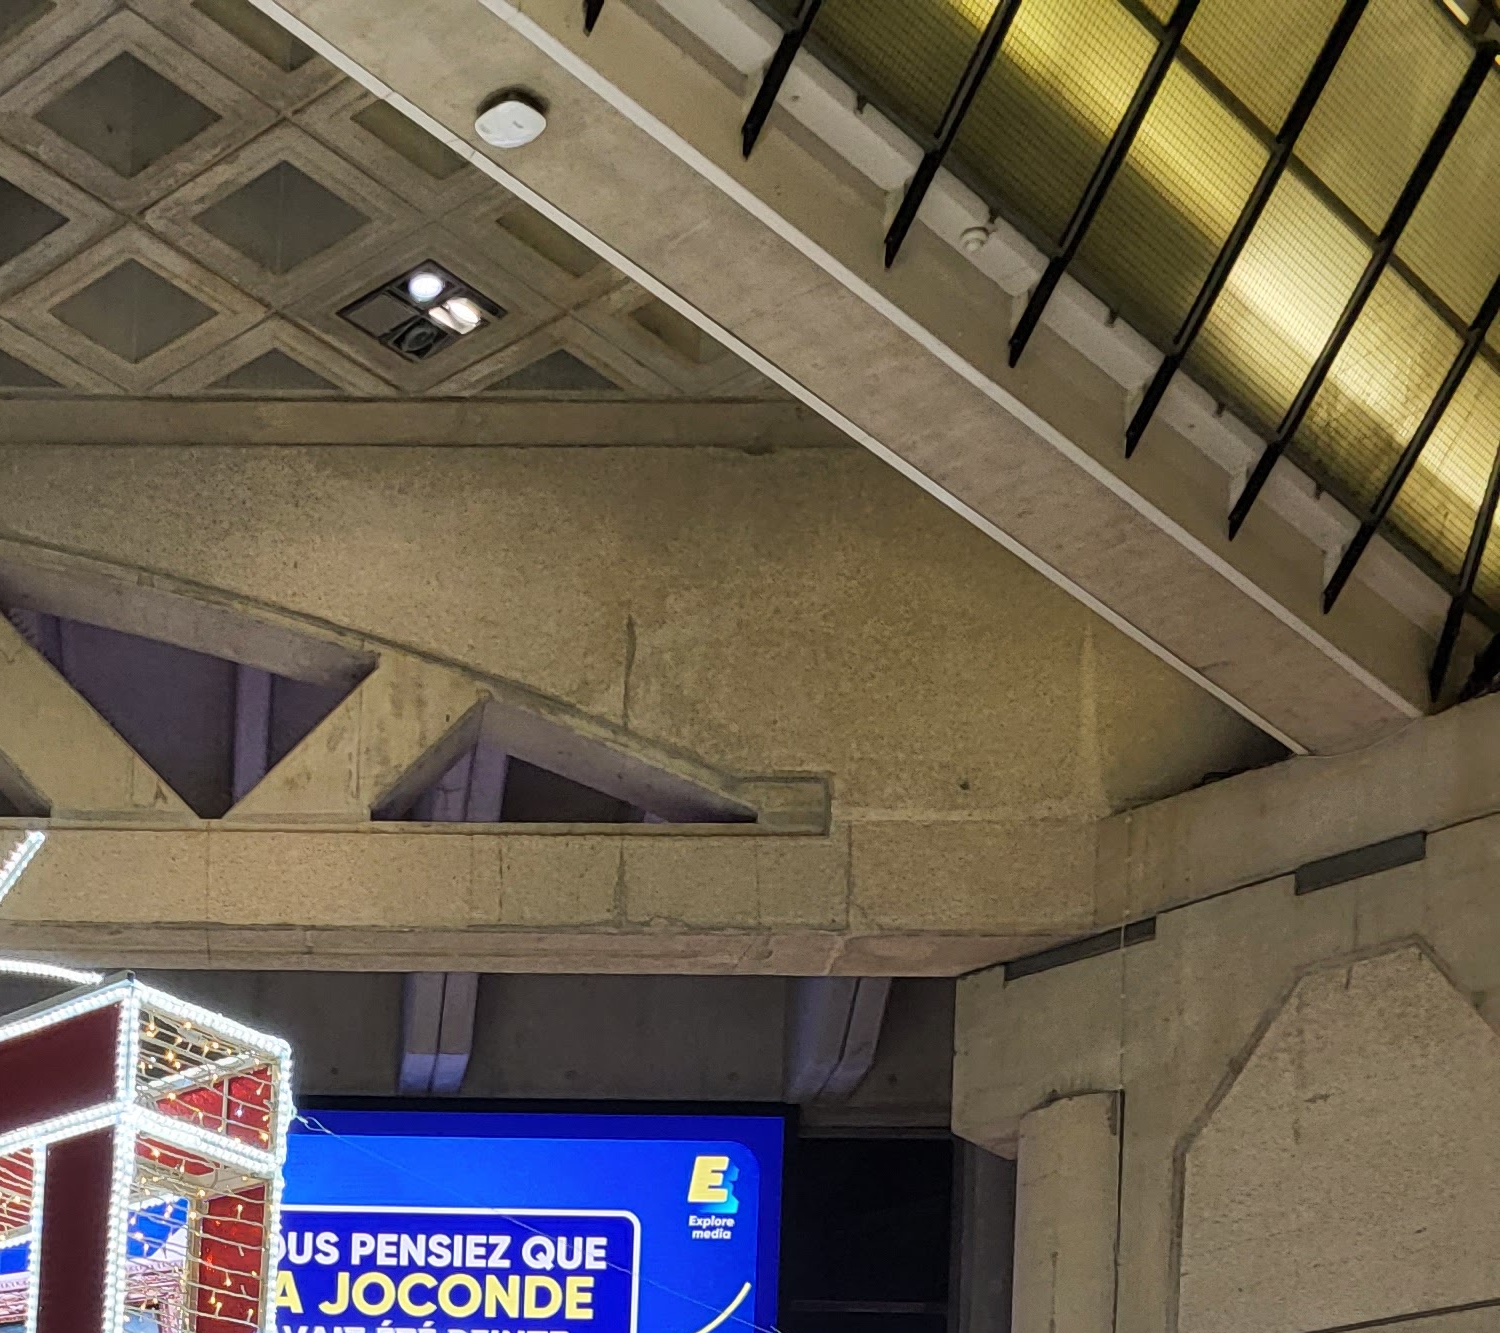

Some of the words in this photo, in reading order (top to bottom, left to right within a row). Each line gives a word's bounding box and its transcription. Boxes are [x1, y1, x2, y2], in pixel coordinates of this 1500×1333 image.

[688, 1215, 736, 1229] Explore
[691, 1228, 732, 1239] media
[351, 1233, 512, 1268] PENSIEZ
[521, 1235, 608, 1271] QUE
[275, 1270, 304, 1314] A
[318, 1271, 595, 1320] JOCONDE
